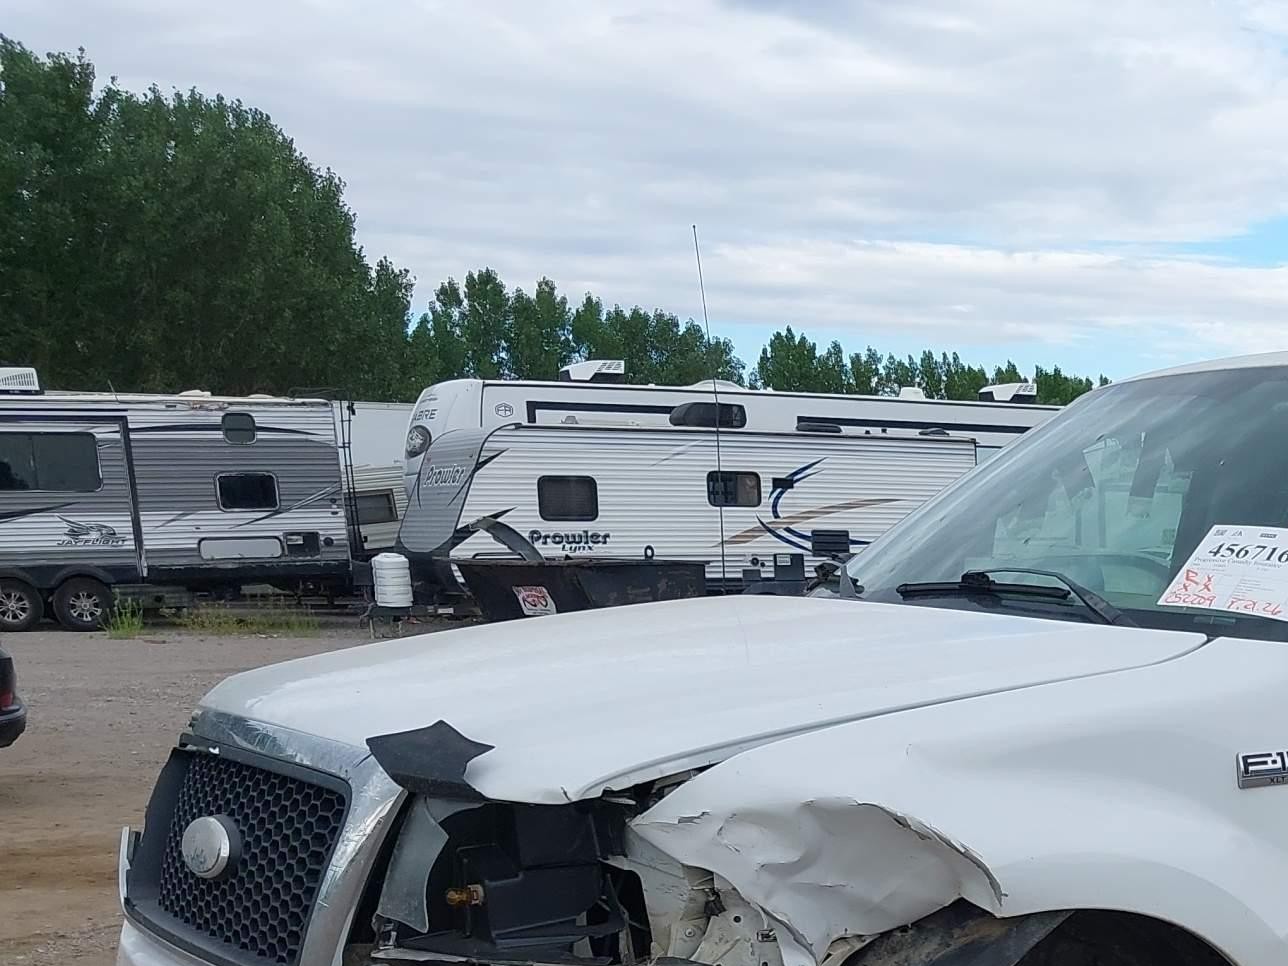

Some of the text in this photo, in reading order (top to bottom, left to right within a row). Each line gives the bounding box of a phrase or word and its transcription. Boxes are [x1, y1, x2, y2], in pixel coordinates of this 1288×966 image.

[424, 464, 466, 487] Prowler
[528, 529, 610, 545] Prowler
[561, 544, 594, 553] Lynx
